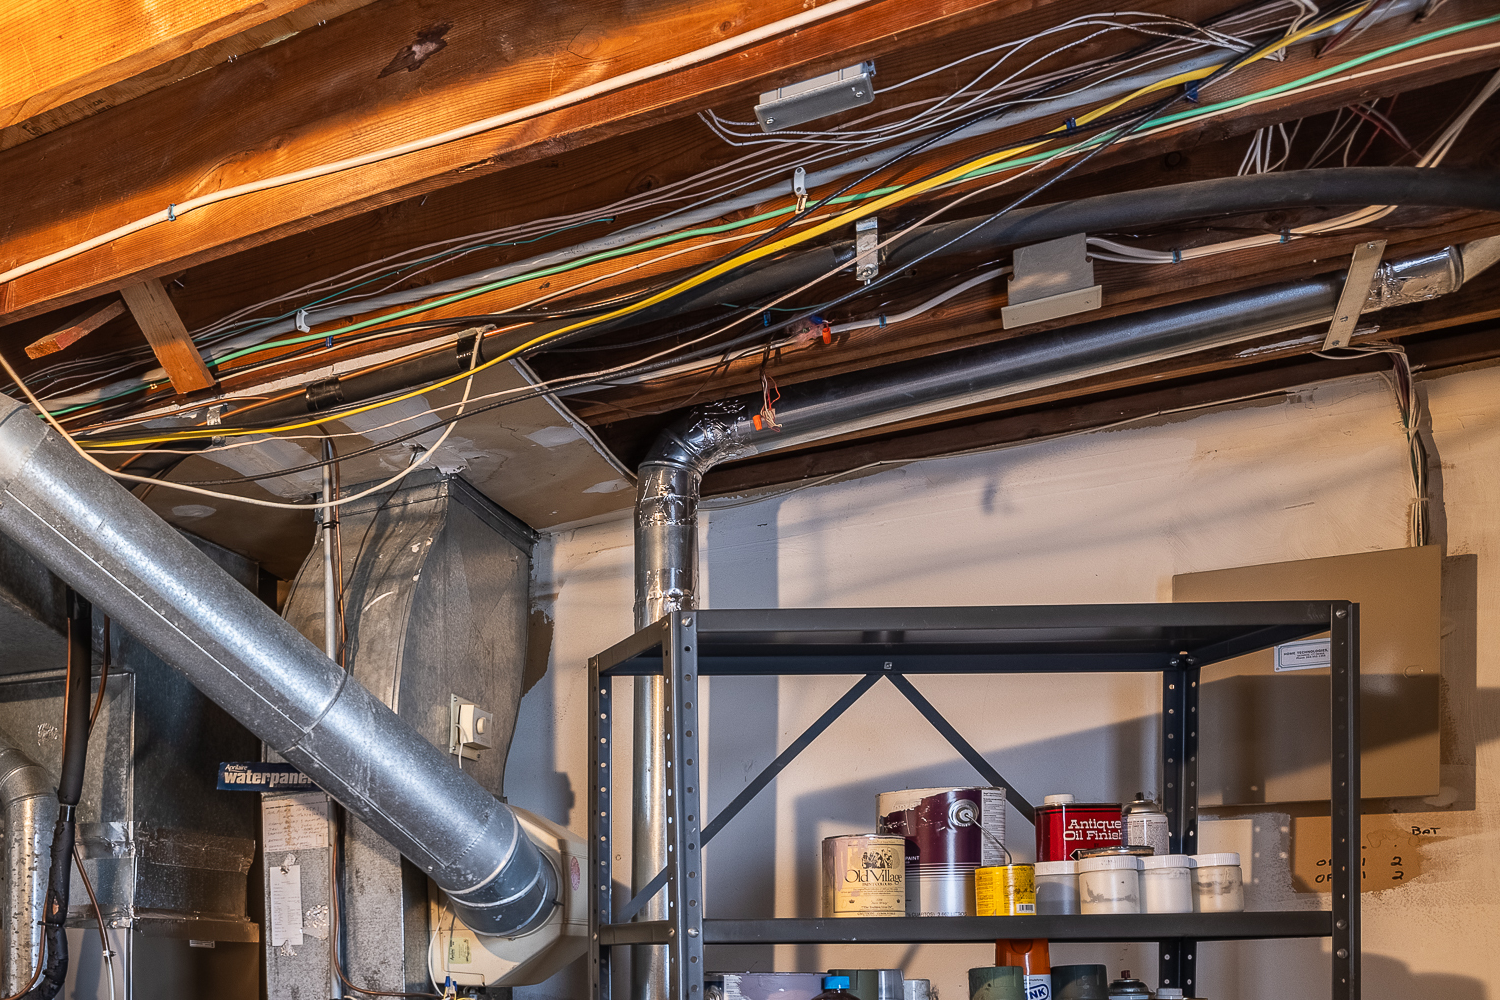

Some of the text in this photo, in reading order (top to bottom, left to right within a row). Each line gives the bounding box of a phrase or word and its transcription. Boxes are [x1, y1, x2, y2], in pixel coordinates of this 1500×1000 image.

[1067, 818, 1122, 832] Antique
[1063, 830, 1084, 840] Oil
[1390, 856, 1402, 866] 2
[844, 868, 902, 886] Old Village
[1392, 870, 1404, 880] 2
